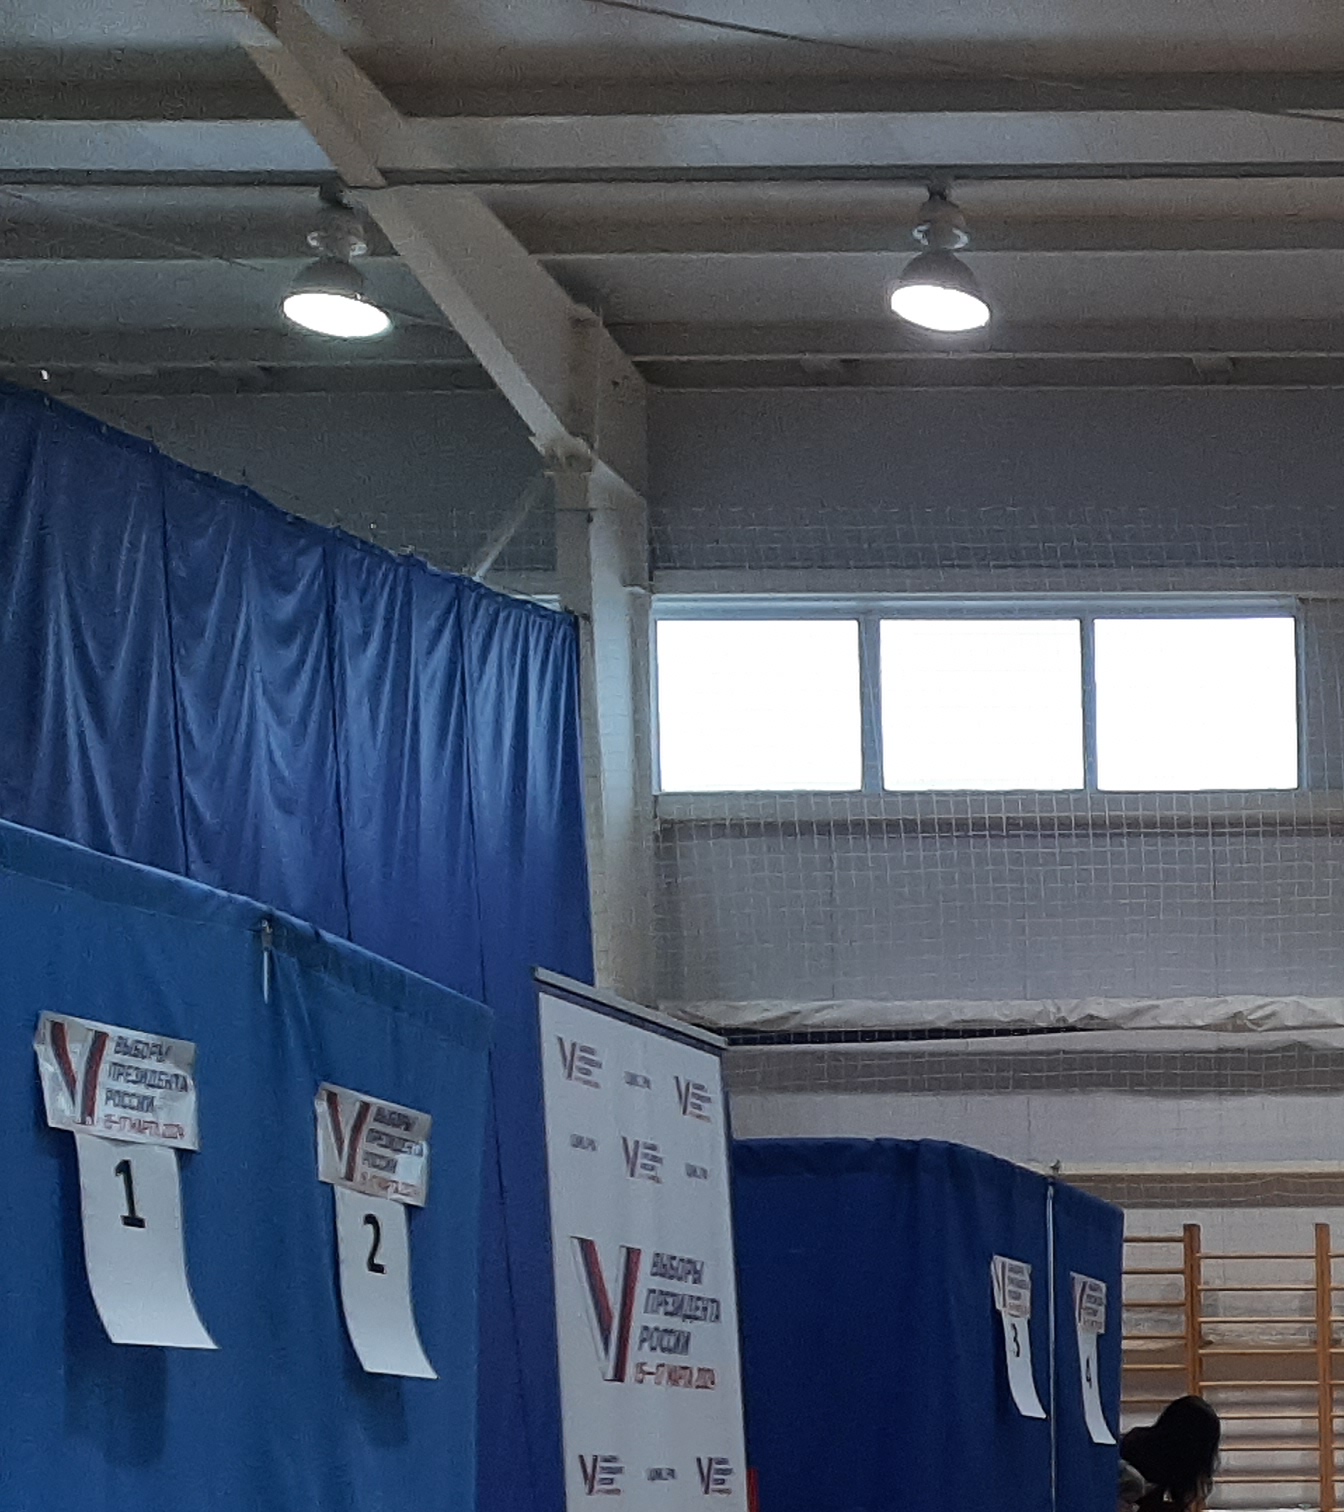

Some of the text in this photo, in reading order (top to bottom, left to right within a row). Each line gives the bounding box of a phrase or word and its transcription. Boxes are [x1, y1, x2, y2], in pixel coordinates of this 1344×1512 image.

[114, 1159, 146, 1229] 1
[362, 1213, 388, 1275] 2
[650, 1252, 705, 1285] ВЫБОРЫ
[643, 1287, 721, 1323] ПРЕЗИДЕНТА
[637, 1325, 692, 1356] РОССИИ
